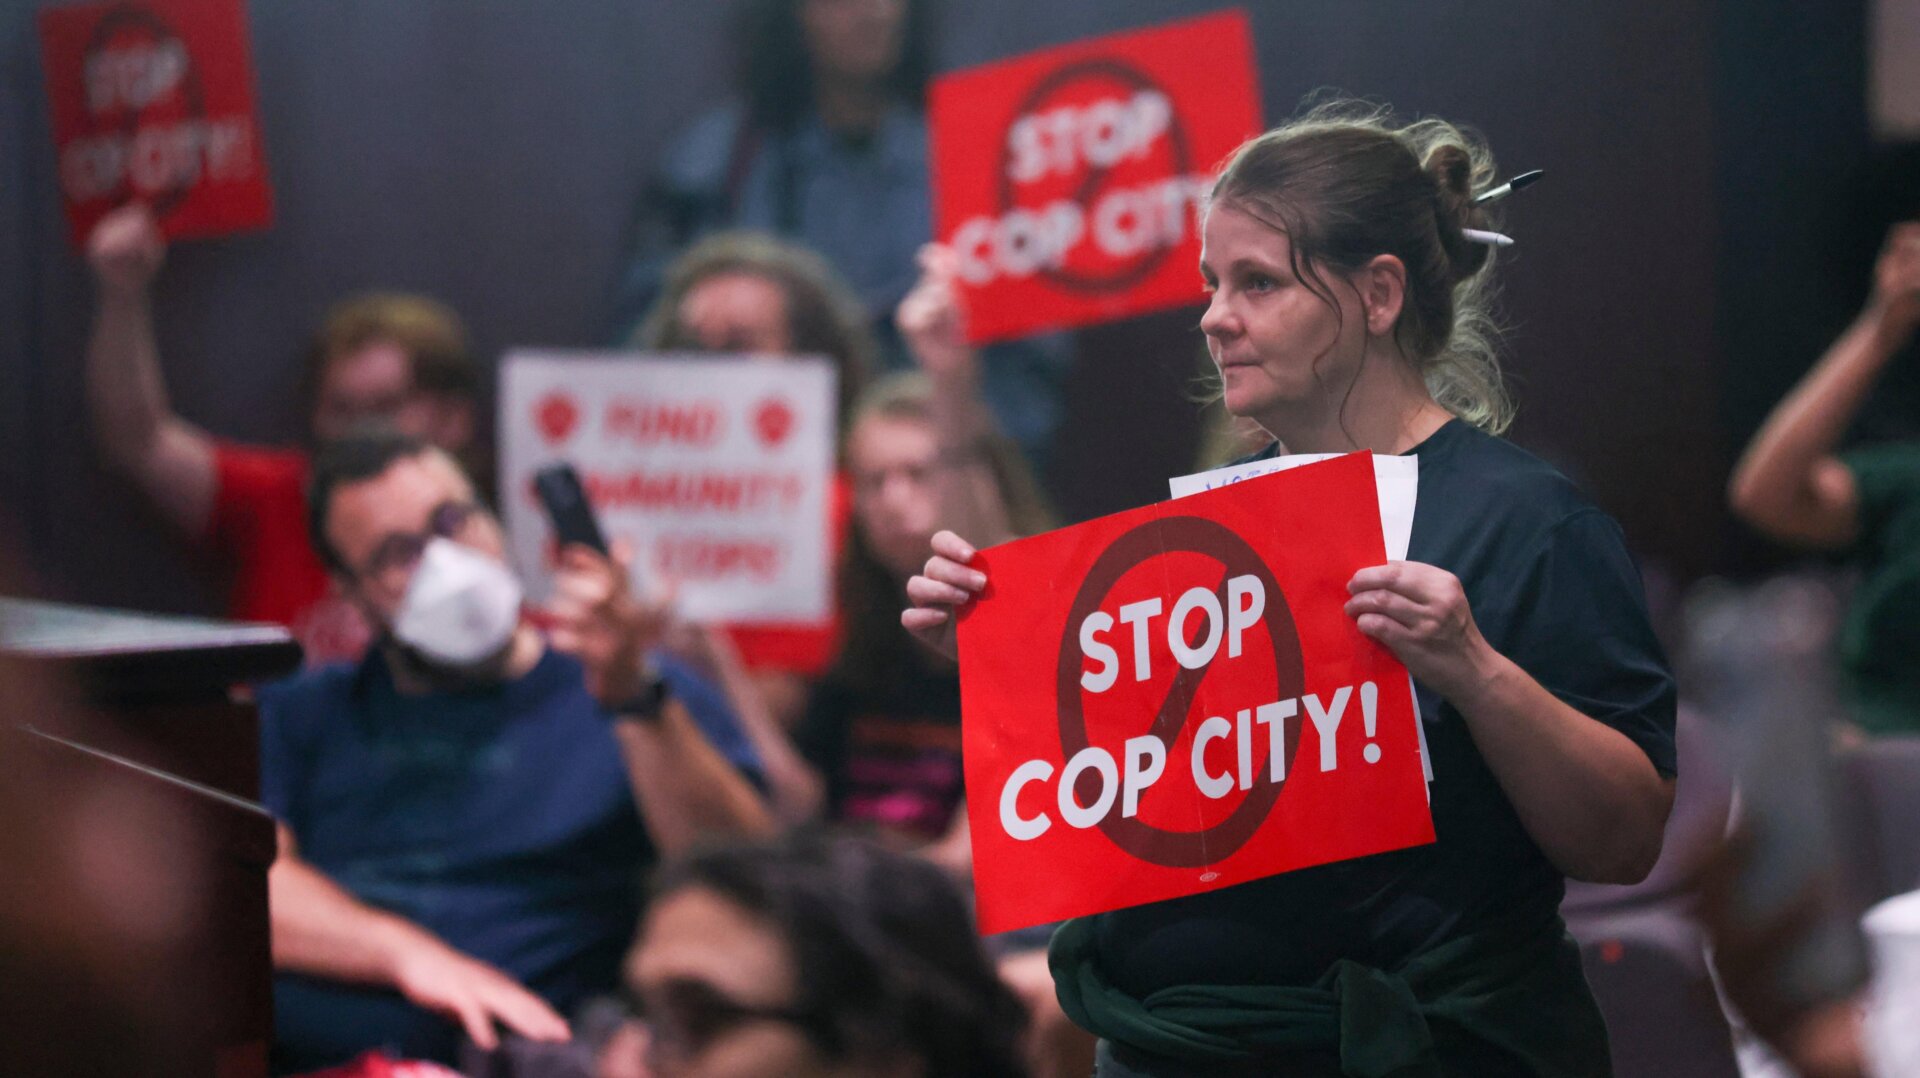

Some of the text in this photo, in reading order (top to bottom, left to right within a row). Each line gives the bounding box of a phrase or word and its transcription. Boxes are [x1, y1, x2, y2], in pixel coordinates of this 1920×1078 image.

[1007, 89, 1171, 183] STOP
[952, 201, 1083, 285] COP
[1079, 574, 1265, 693] STOP
[1000, 681, 1382, 841] COP CITY!
